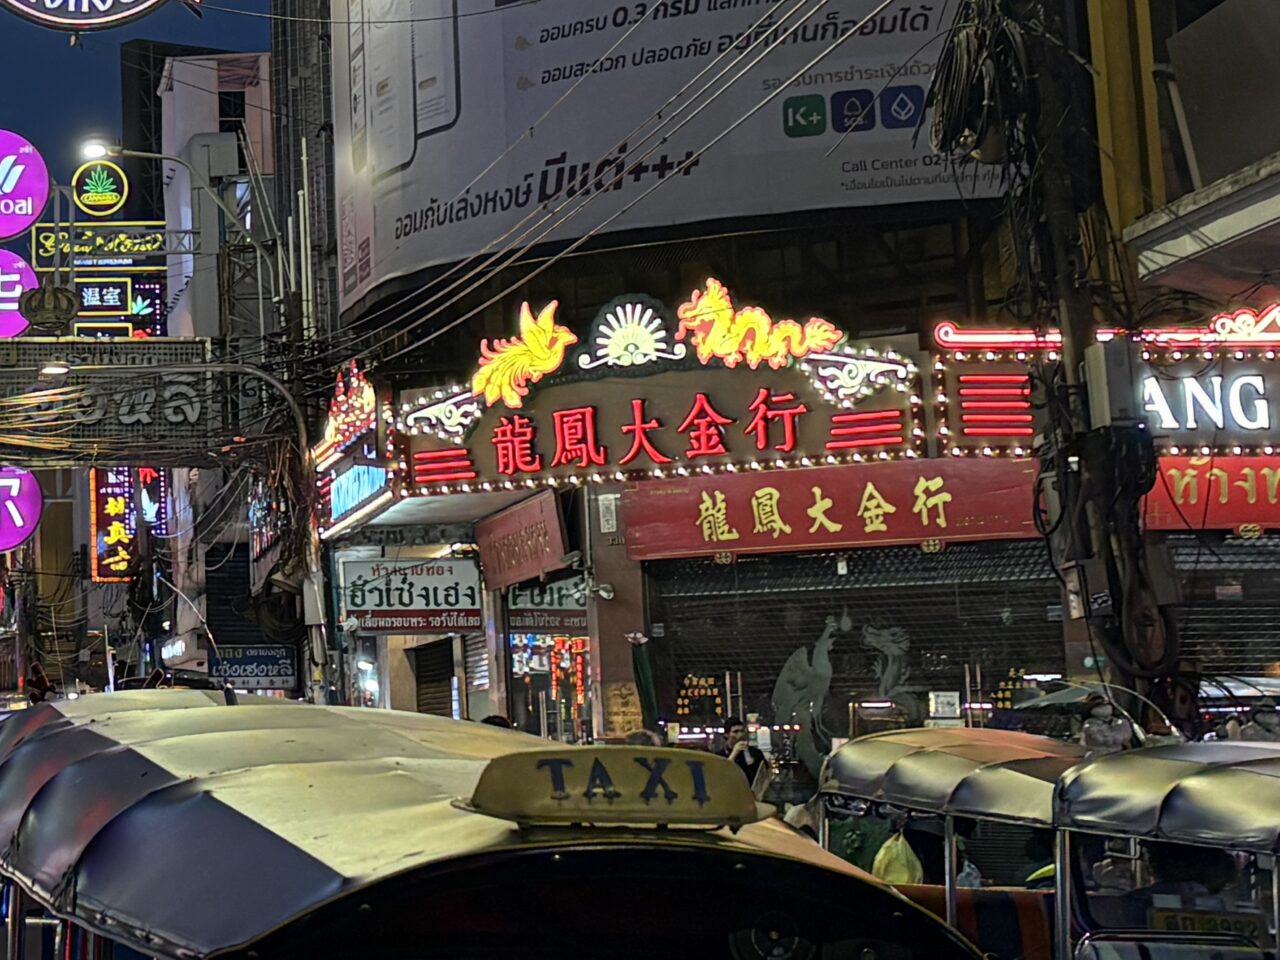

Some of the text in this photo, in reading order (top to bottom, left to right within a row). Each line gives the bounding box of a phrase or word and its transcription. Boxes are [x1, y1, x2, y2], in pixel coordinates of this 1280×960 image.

[539, 14, 608, 45] ออมครบ
[612, 4, 647, 30] 0.3
[787, 107, 822, 127] K+
[841, 160, 868, 173] Call
[871, 157, 918, 171] Center
[490, 386, 810, 476] 龍鳳大金行
[695, 475, 953, 542] 龍鳳大金行
[535, 757, 712, 804] TAXI
